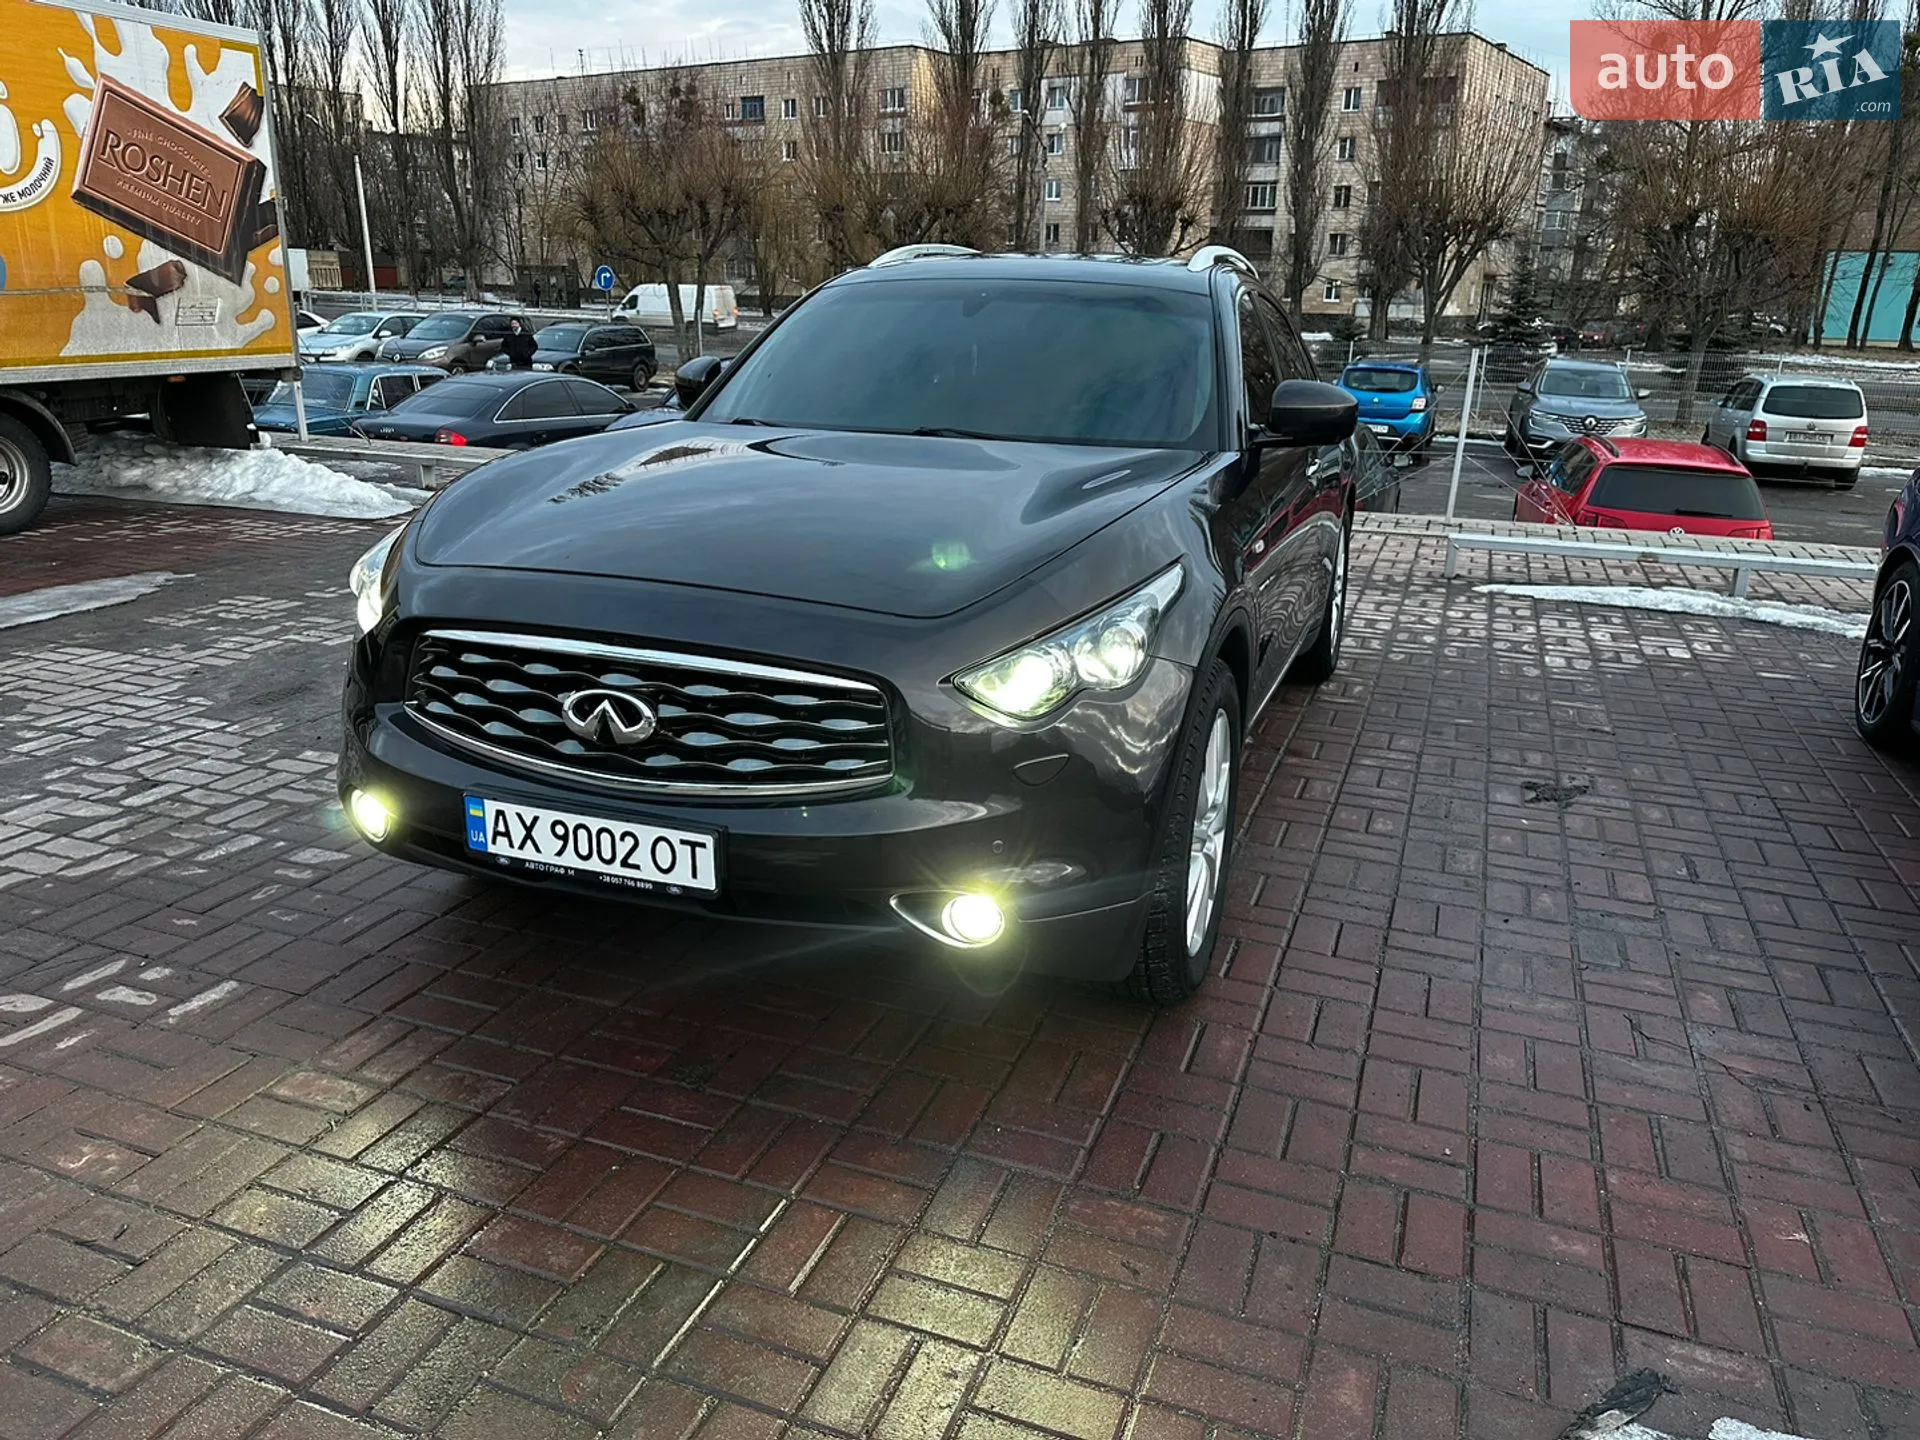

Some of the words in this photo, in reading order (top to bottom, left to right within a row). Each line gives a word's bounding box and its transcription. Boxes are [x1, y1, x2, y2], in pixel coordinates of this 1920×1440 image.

[16, 156, 55, 200] МОЛОЧНИЙ
[99, 129, 228, 218] ROSHEN
[470, 829, 486, 844] UA
[491, 808, 542, 854] AX
[550, 819, 642, 871] 9002
[650, 835, 707, 880] OT
